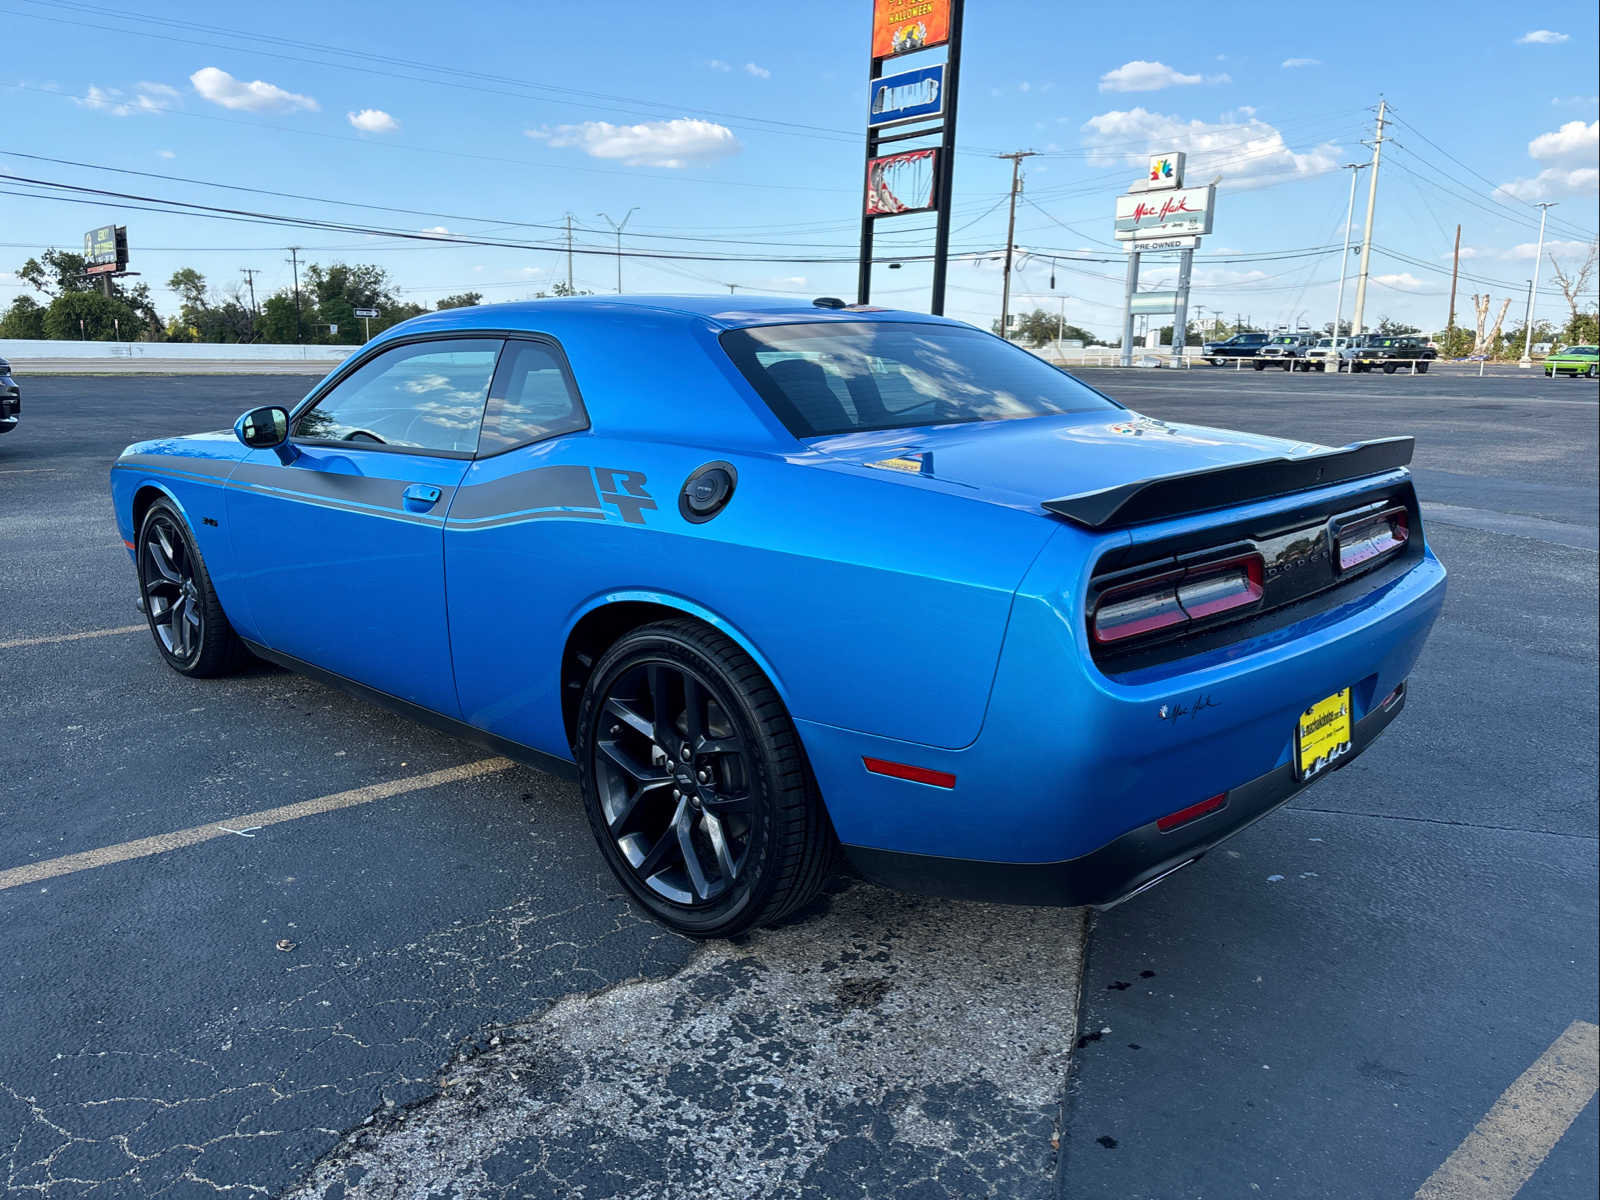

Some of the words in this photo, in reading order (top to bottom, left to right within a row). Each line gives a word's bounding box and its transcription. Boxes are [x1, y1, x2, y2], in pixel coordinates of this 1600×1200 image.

[888, 3, 934, 25] HALLOWEEN
[1127, 202, 1157, 224] Mac
[1159, 196, 1197, 221] Haik
[1134, 240, 1182, 250] PRE-OWNED
